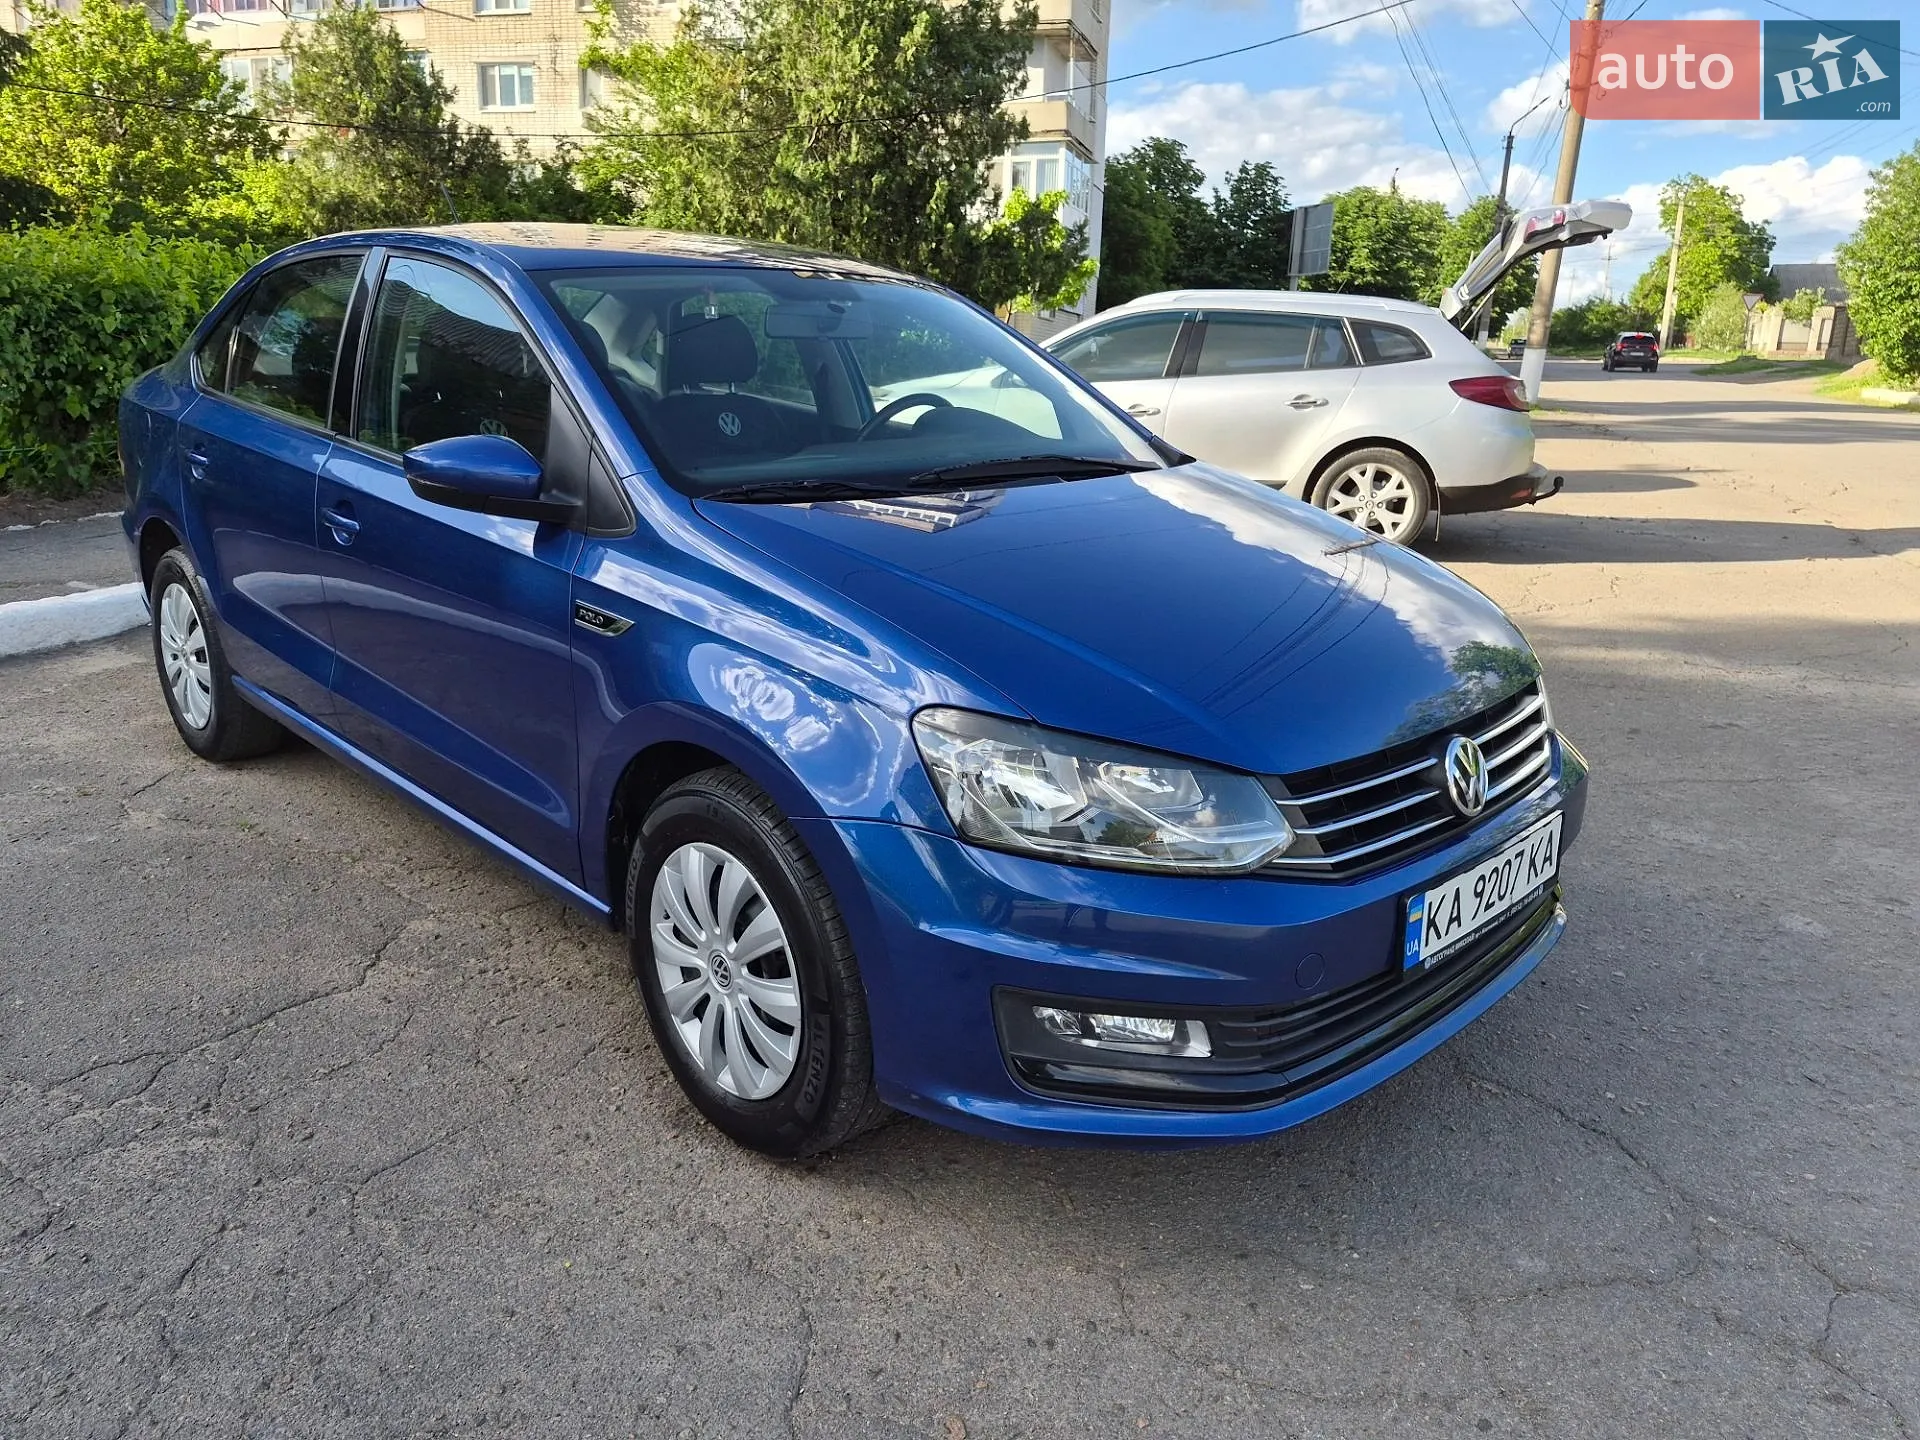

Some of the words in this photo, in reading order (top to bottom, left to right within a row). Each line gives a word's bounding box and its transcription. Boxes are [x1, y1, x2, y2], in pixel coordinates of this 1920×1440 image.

[579, 609, 604, 624] POLO
[1425, 887, 1462, 947] KA
[1472, 849, 1525, 921] 9207
[1527, 830, 1553, 885] KA
[1406, 940, 1419, 957] UA
